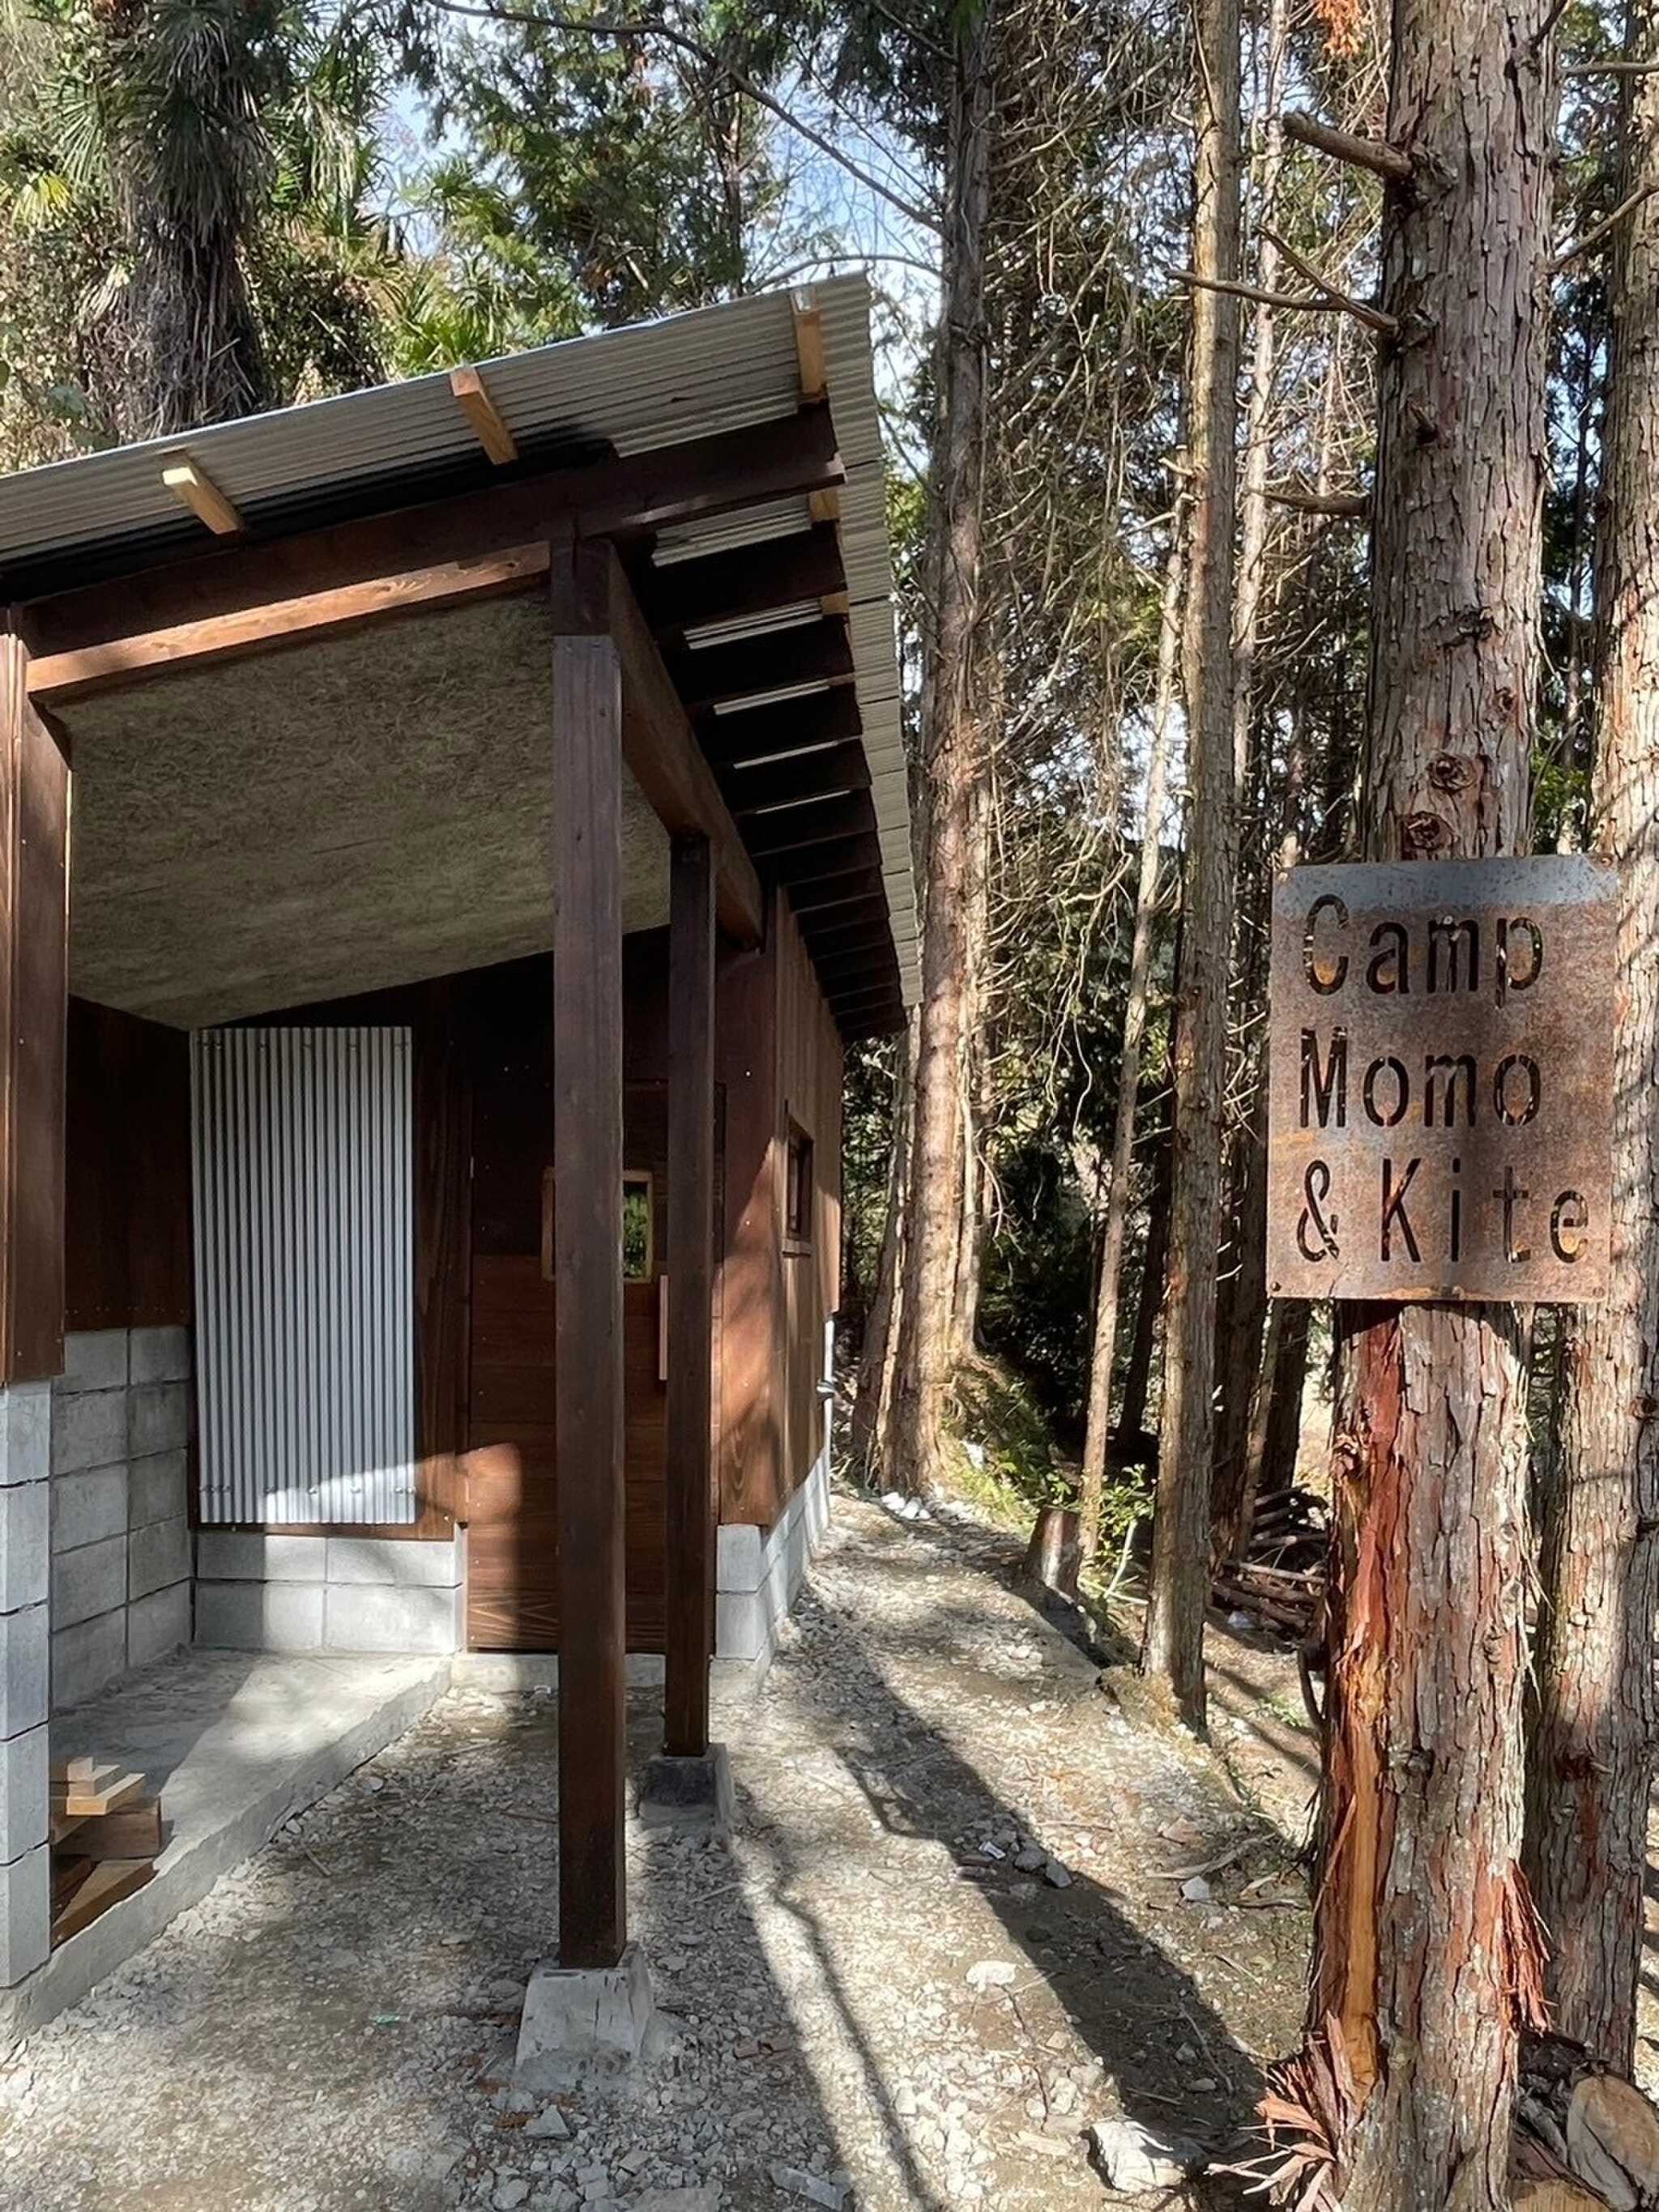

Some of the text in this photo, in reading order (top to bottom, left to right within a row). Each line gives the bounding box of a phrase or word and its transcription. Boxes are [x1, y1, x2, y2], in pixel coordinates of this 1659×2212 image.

[1303, 893, 1543, 1009] Camp
[1299, 1025, 1542, 1128] Momo
[1296, 1157, 1589, 1264] & Kite
